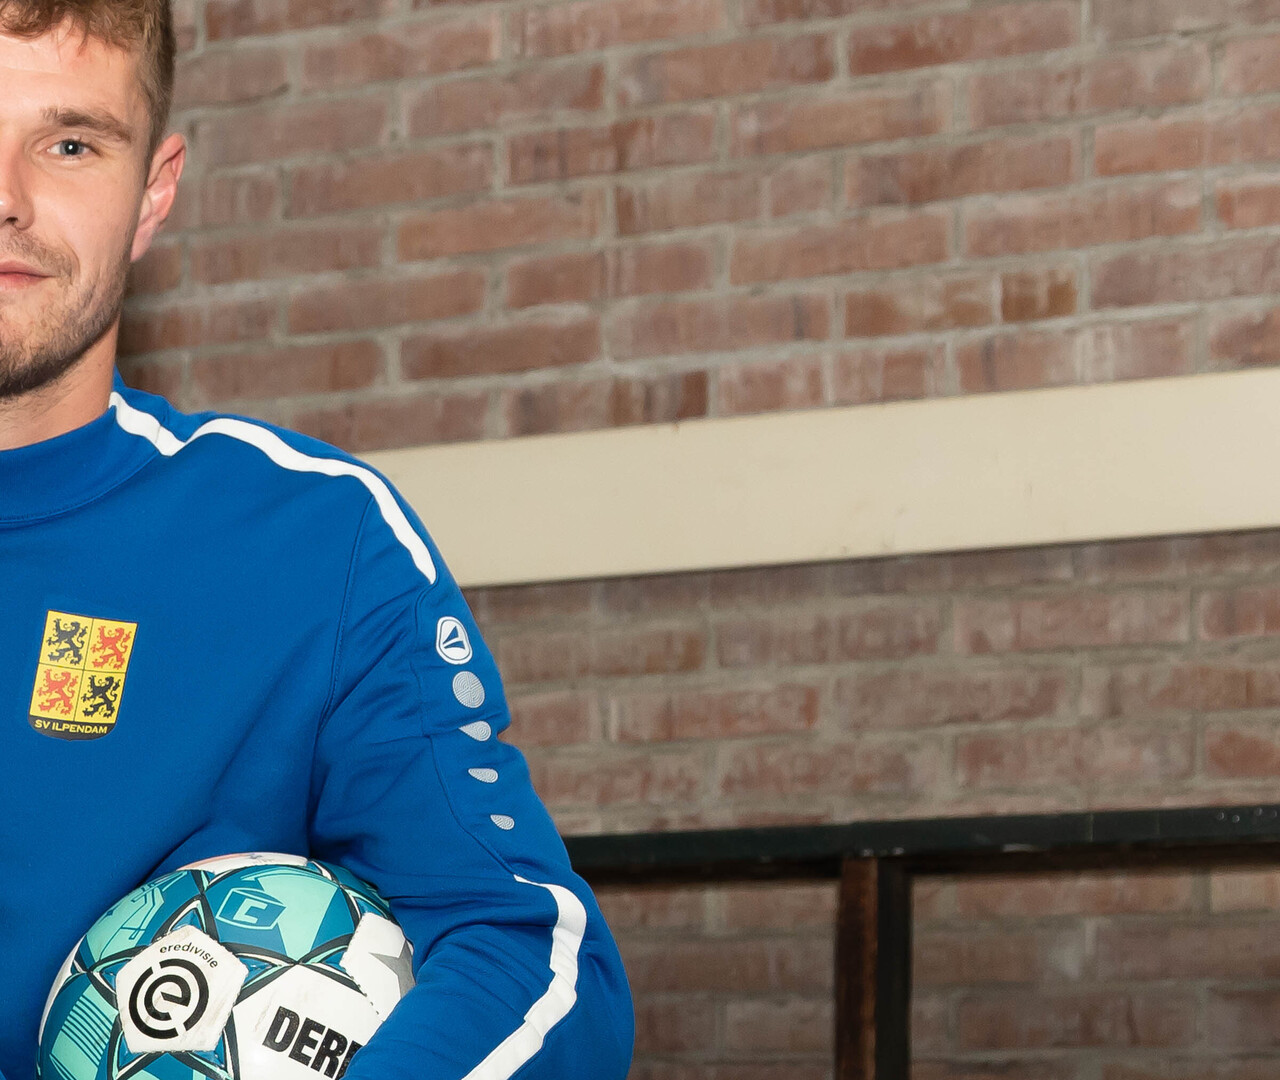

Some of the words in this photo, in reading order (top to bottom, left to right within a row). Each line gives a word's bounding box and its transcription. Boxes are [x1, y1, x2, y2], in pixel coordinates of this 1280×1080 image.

[34, 719, 51, 730] SV
[52, 721, 108, 734] ILPENDAM
[159, 942, 218, 969] eredivisie
